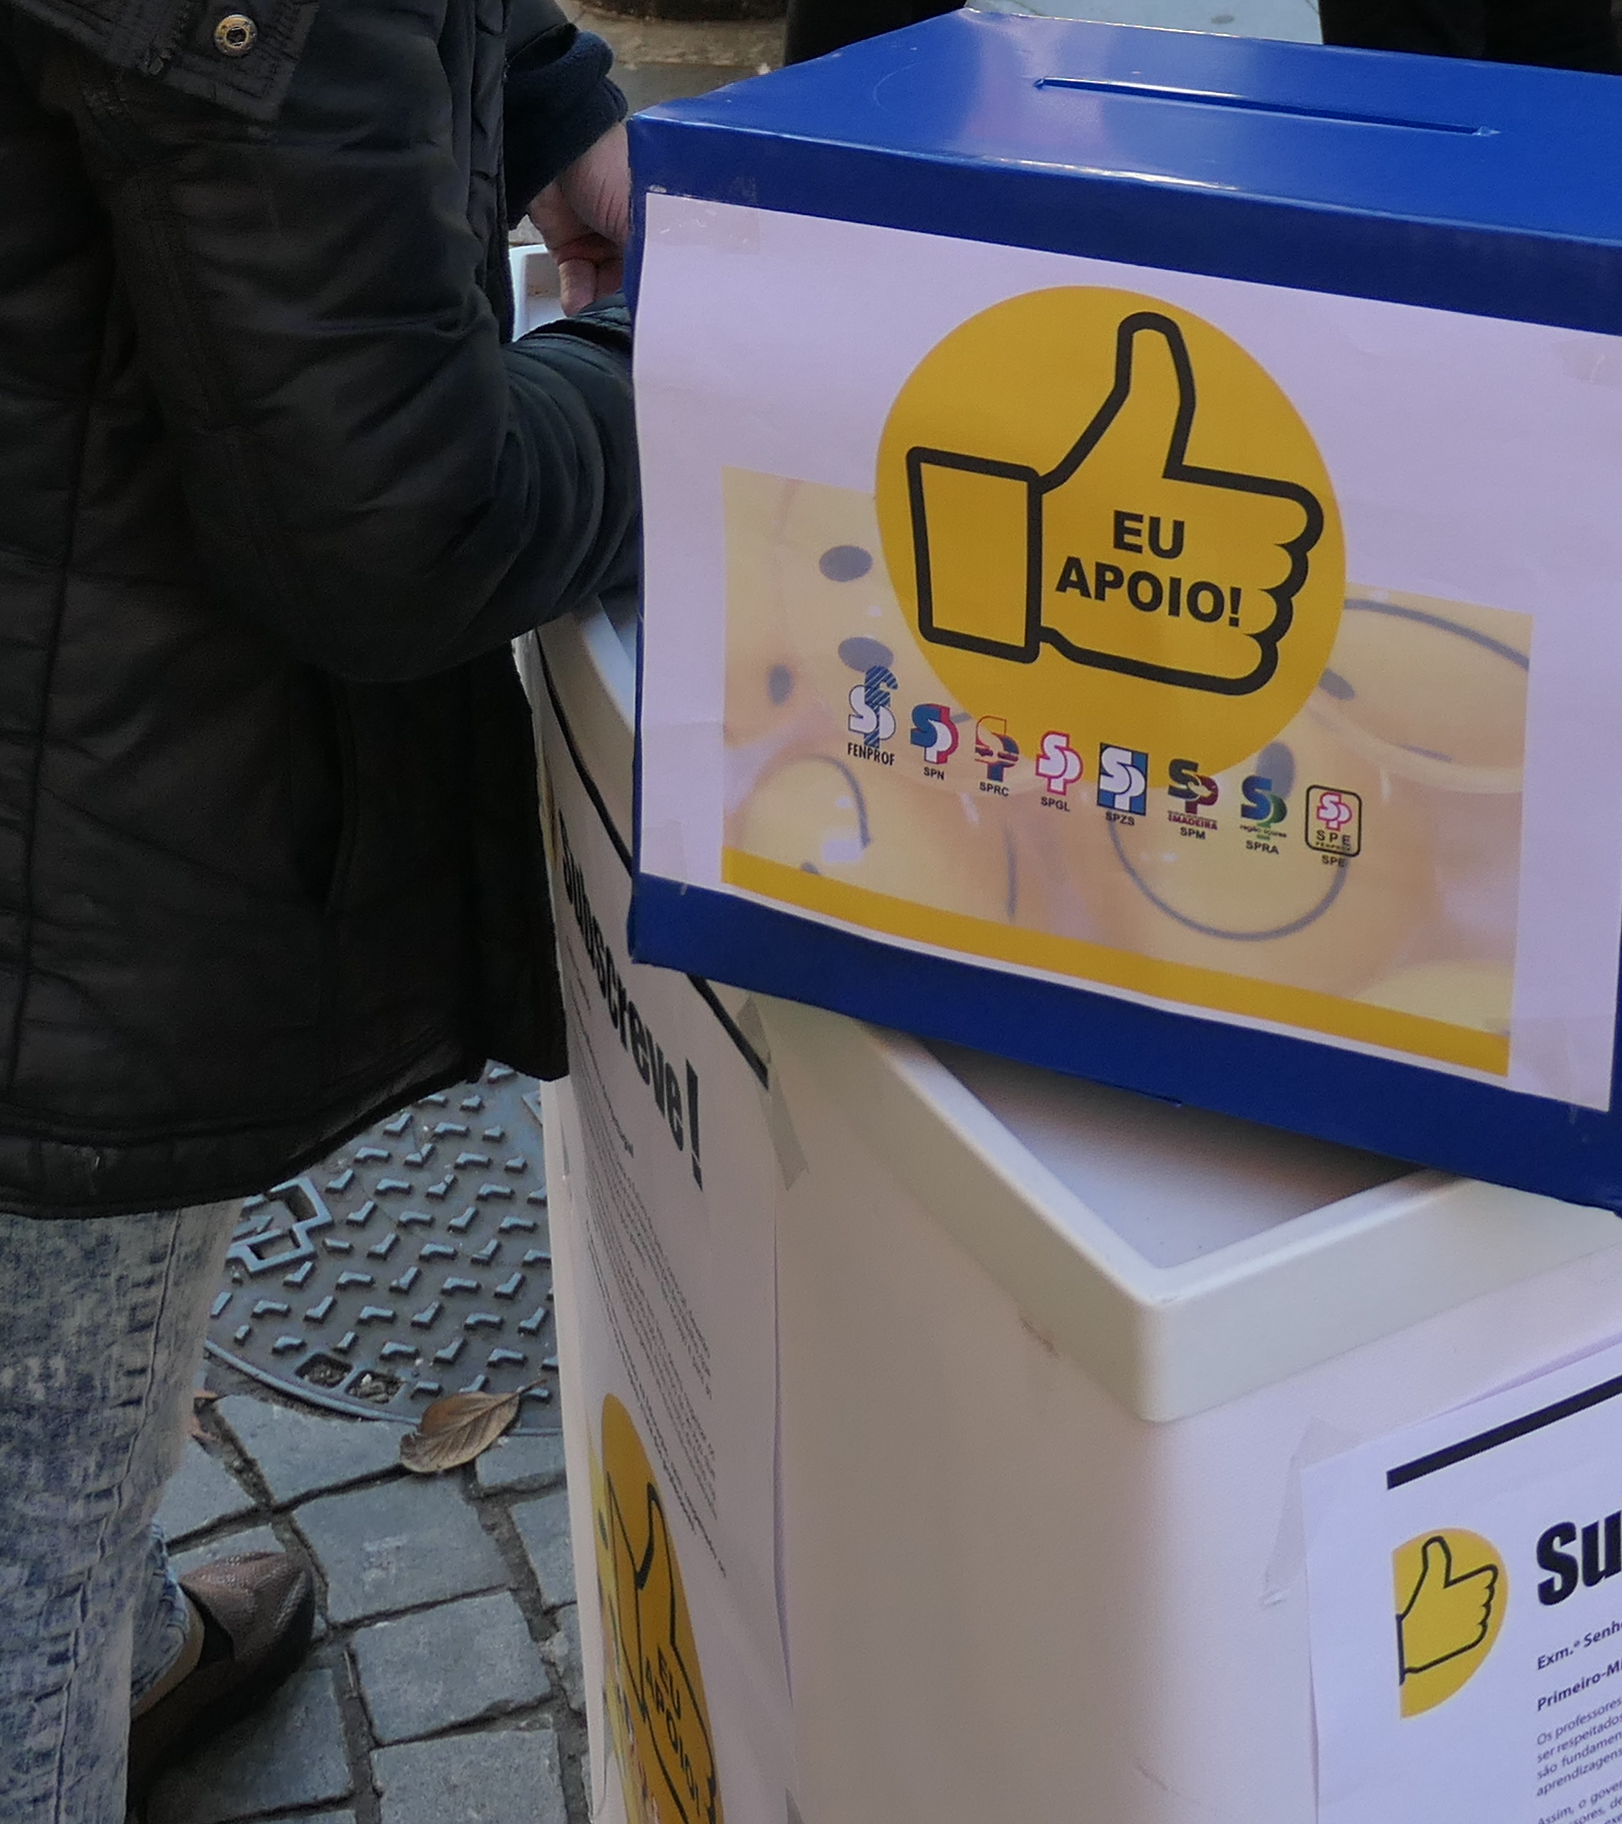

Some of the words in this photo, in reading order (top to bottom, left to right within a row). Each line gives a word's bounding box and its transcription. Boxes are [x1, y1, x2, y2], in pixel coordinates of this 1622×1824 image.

[1113, 509, 1185, 560] EU
[1055, 556, 1242, 628] APOIO!
[847, 741, 896, 766] FENPROF
[923, 766, 945, 781] SPN
[979, 781, 1010, 797] SPRC
[1040, 796, 1071, 812] SPGL
[1105, 810, 1135, 827] SPZS
[1180, 826, 1206, 840] SPM
[1245, 840, 1279, 855] SPRA
[1322, 854, 1345, 868] SPE
[1536, 1746, 1555, 1764] ser
[1536, 1763, 1558, 1781] são
